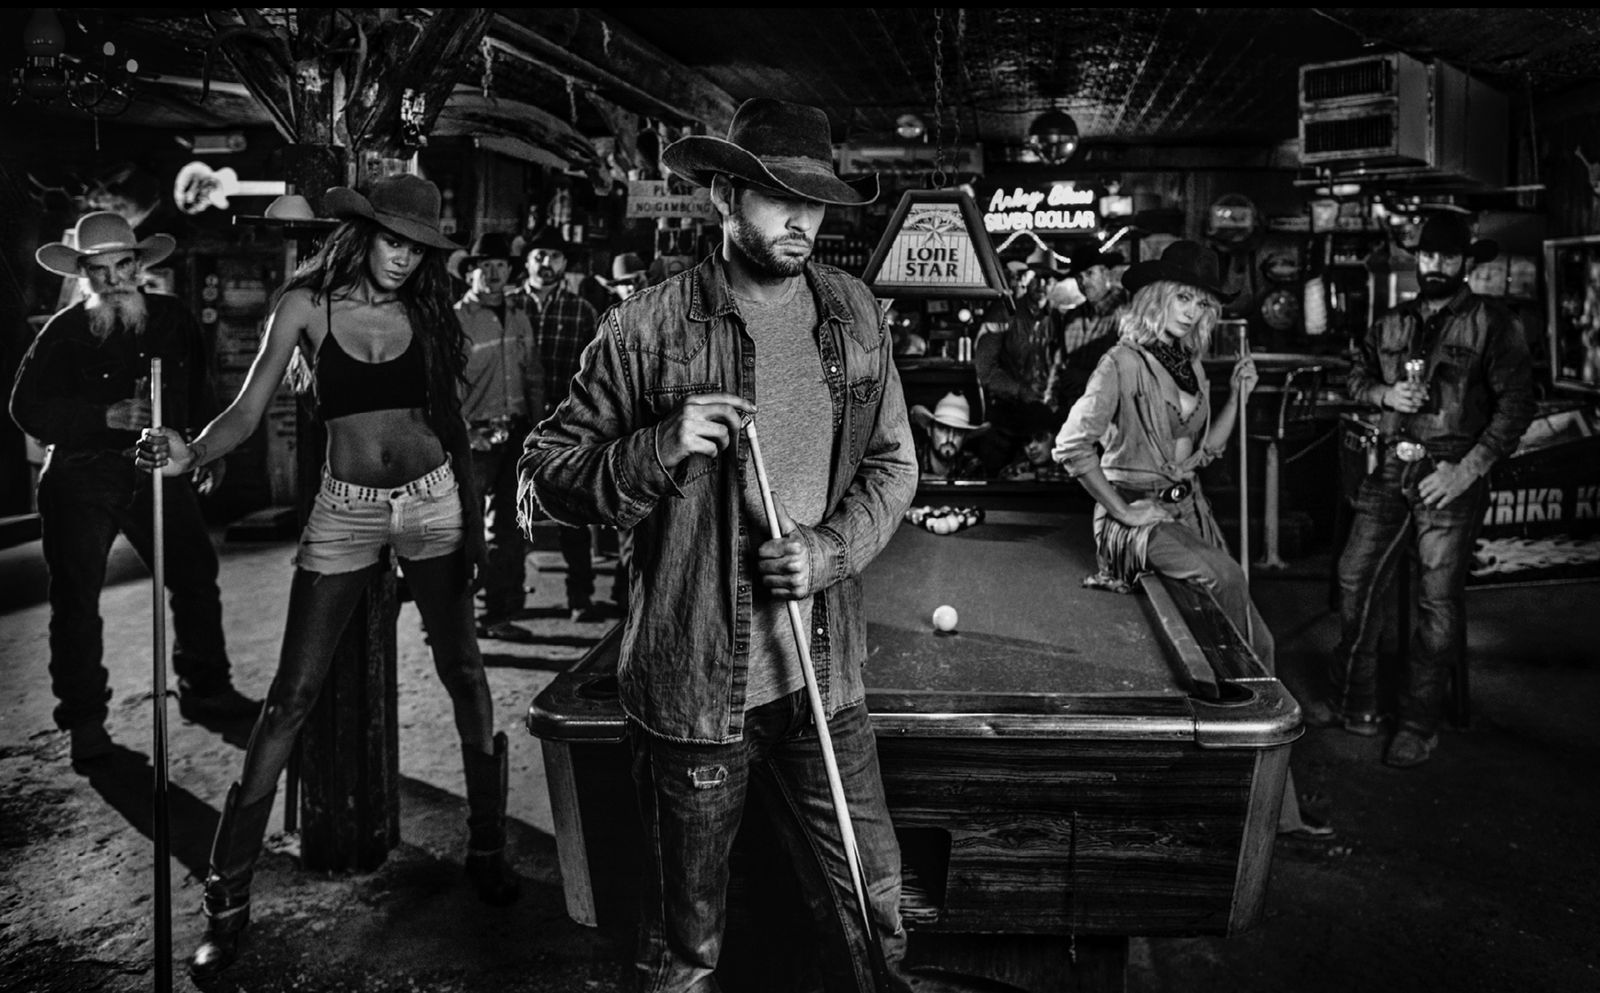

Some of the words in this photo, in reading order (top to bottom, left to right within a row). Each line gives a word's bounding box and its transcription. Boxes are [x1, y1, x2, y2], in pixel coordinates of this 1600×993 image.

[983, 211, 1033, 232] SILVER
[1034, 210, 1095, 228] DOLLAR
[905, 262, 958, 277] STAR
